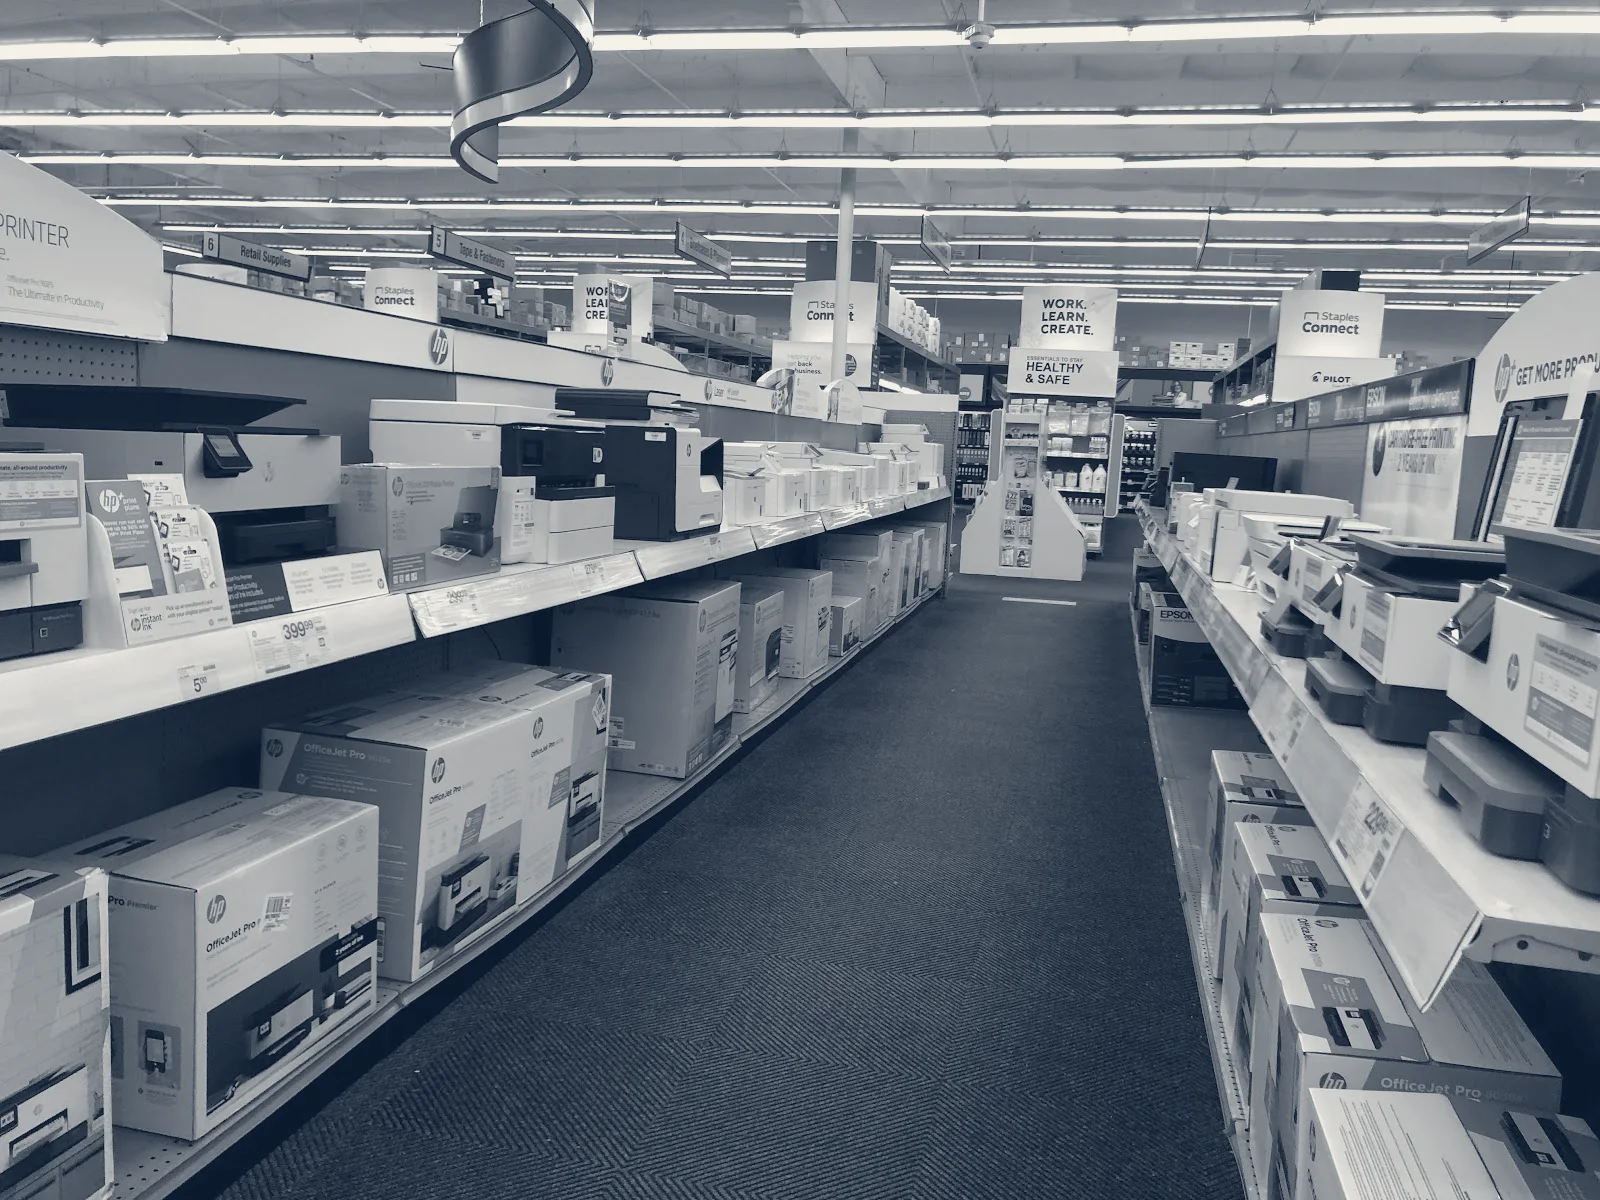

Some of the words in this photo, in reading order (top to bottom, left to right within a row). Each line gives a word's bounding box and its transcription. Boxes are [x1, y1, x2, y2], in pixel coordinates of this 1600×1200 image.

[208, 238, 214, 251] 6
[436, 234, 441, 247] 5
[241, 245, 261, 260] Retail
[263, 251, 291, 267] Supplies
[460, 242, 472, 258] Tape
[474, 247, 478, 259] &
[480, 249, 505, 268] Fasteners
[384, 287, 414, 295] Staples
[8, 286, 22, 297] The
[24, 289, 55, 301] Ultimate
[57, 295, 62, 303] in
[64, 295, 104, 310] Productivity
[375, 296, 414, 305] Connect
[1043, 299, 1087, 309] WORK.
[807, 311, 854, 321] Connt
[1042, 312, 1088, 322] LEARN.
[1322, 312, 1360, 323] Staples
[1041, 324, 1094, 335] CREATE.
[1302, 322, 1359, 334] Connect
[432, 329, 448, 365] hp
[1026, 361, 1083, 373] HEALTHY
[1516, 366, 1533, 386] GET
[1535, 360, 1562, 382] MORE
[1025, 373, 1033, 384] &
[1037, 374, 1070, 385] SAFE
[141, 614, 162, 624] instant
[304, 743, 347, 757] OfficeJet
[350, 749, 366, 760] Pro
[531, 744, 548, 757] OfficeJet
[429, 790, 452, 804] OfficeJet
[453, 785, 461, 794] Pro
[108, 895, 125, 906] Pro
[127, 899, 158, 911] Premier
[207, 894, 226, 924] hp
[206, 928, 241, 953] OfficeJet
[243, 921, 256, 932] Pro
[1297, 918, 1316, 942] OfficeJet
[1307, 942, 1318, 953] Pro
[1381, 1077, 1450, 1095] OfficeJet
[1455, 1085, 1482, 1098] Pro
